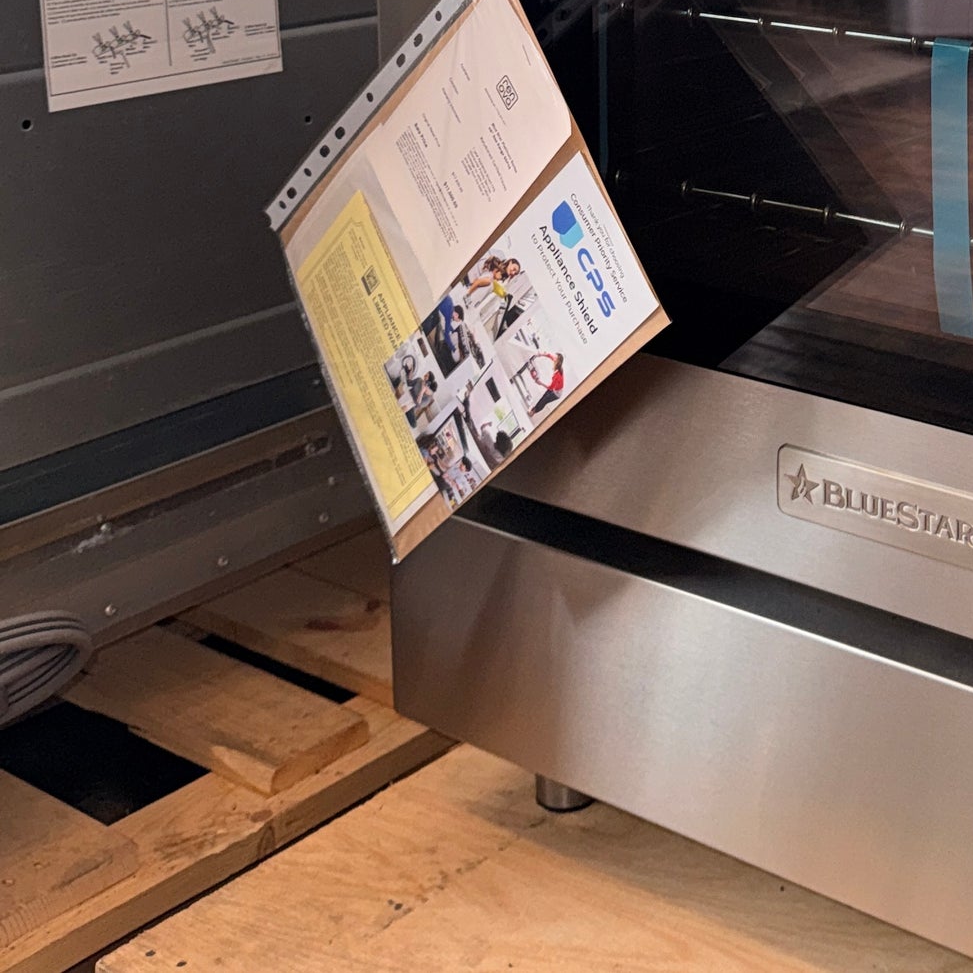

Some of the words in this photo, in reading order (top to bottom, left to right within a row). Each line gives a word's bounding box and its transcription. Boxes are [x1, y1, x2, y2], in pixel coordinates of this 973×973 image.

[531, 234, 538, 245] to
[537, 245, 556, 279] Protect
[555, 277, 567, 300] Your
[565, 301, 588, 345] Purchase
[539, 225, 576, 290] Appliance
[574, 291, 598, 335] Shield
[570, 193, 596, 240] Consumer
[595, 239, 612, 270] Priority
[611, 270, 628, 303] Service
[577, 248, 616, 318] CPS
[588, 204, 600, 227] Thank
[597, 226, 605, 240] you
[610, 247, 624, 279] choosing
